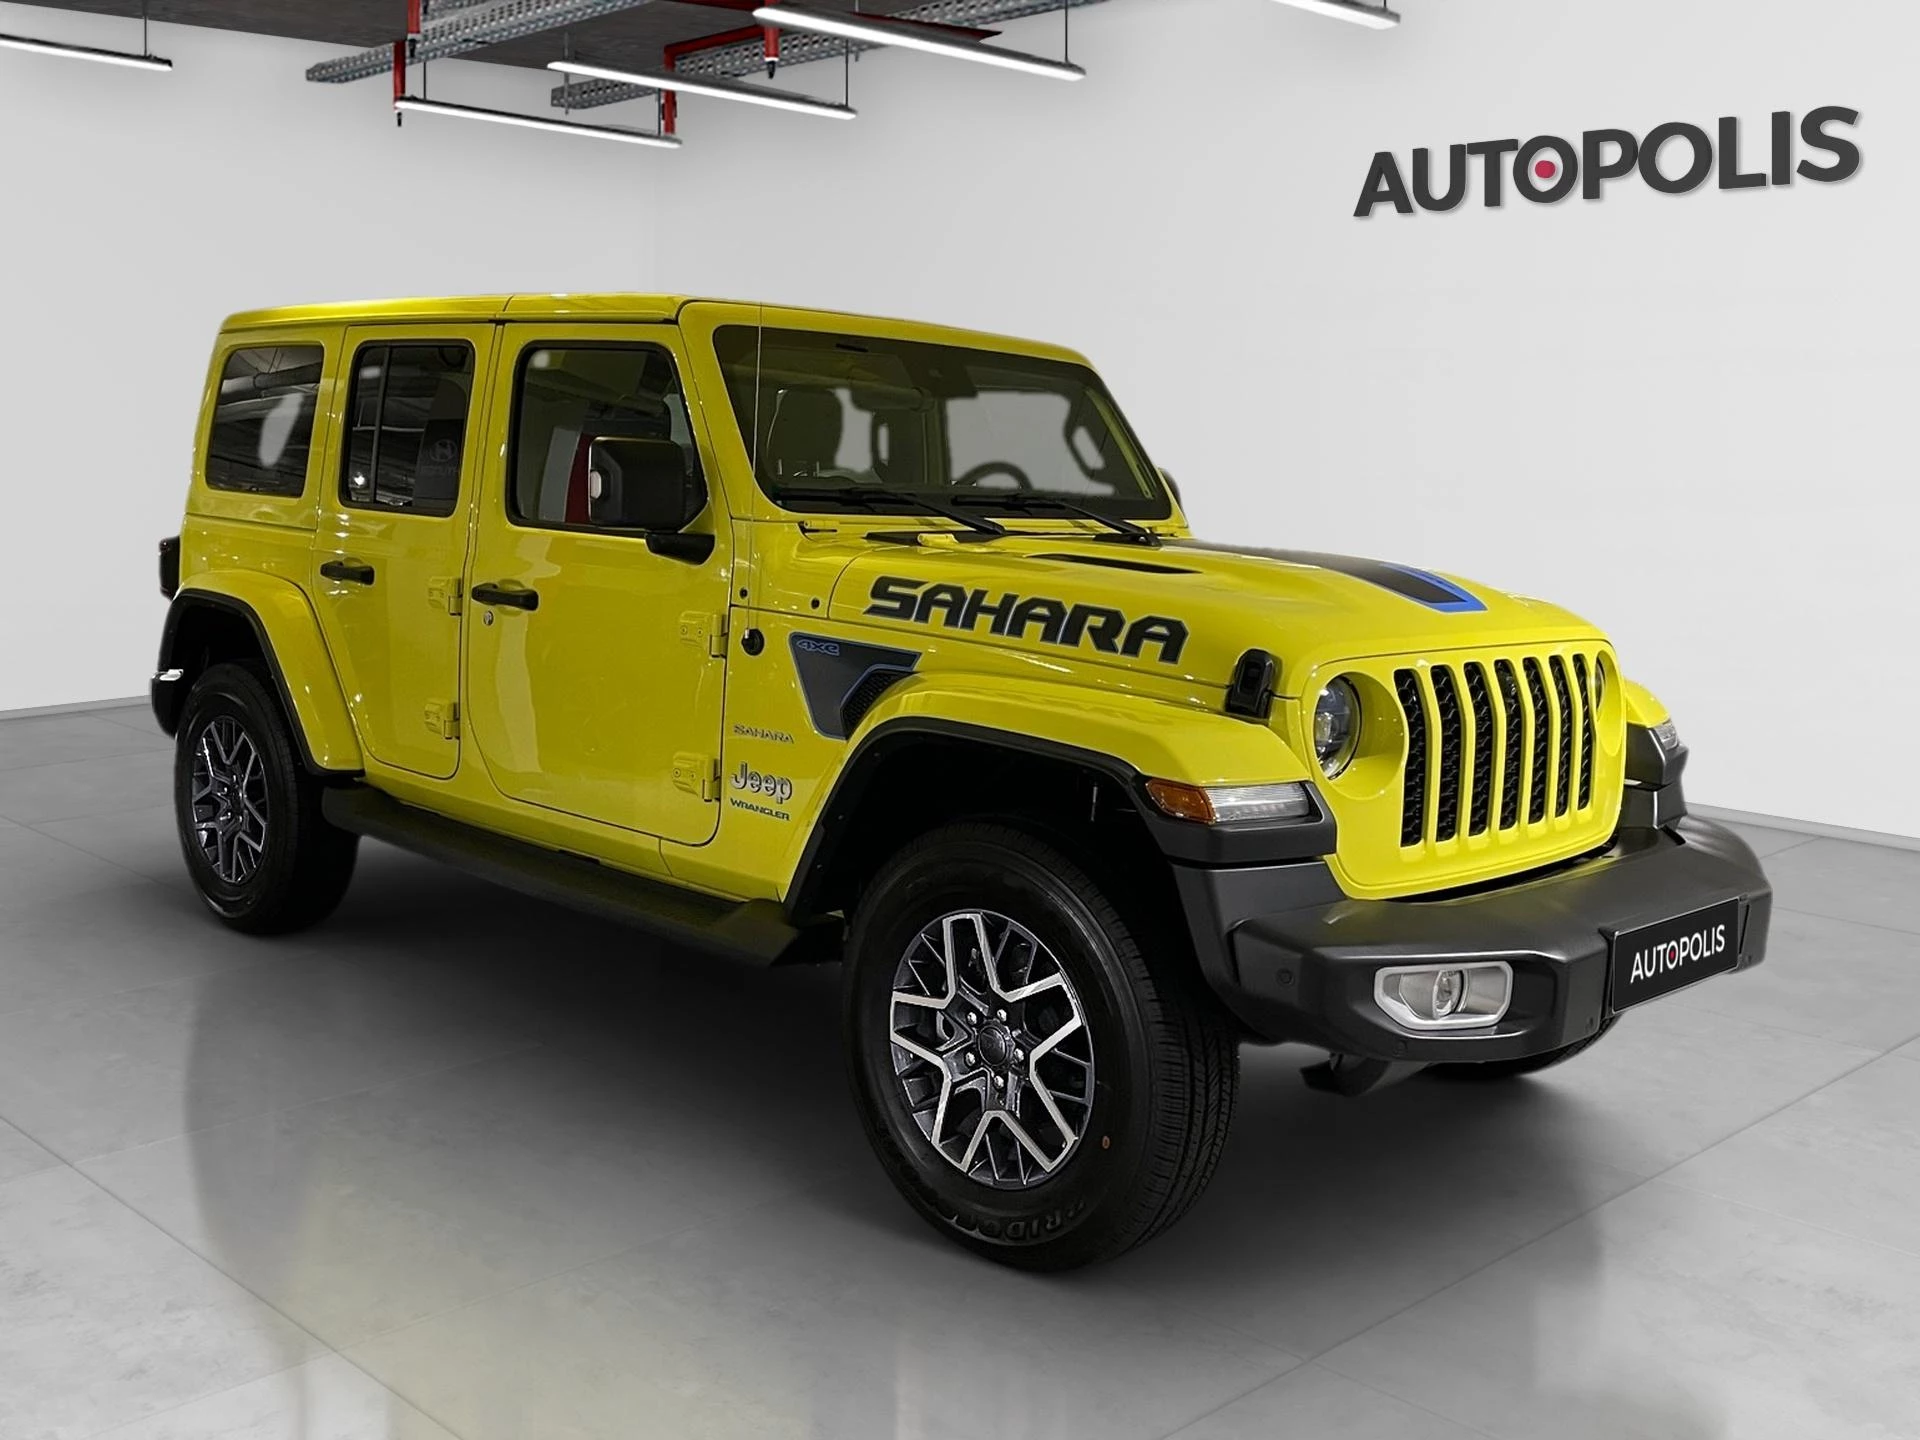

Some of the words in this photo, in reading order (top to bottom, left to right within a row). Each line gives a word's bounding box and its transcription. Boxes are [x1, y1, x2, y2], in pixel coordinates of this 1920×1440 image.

[1353, 105, 1861, 217] AUTOPOLIS
[863, 575, 1190, 664] SAHARA
[733, 724, 795, 744] SAHARA
[730, 797, 791, 820] WRANGLER
[731, 761, 793, 805] Jeep
[1630, 924, 1726, 984] AUTOPOLIS
